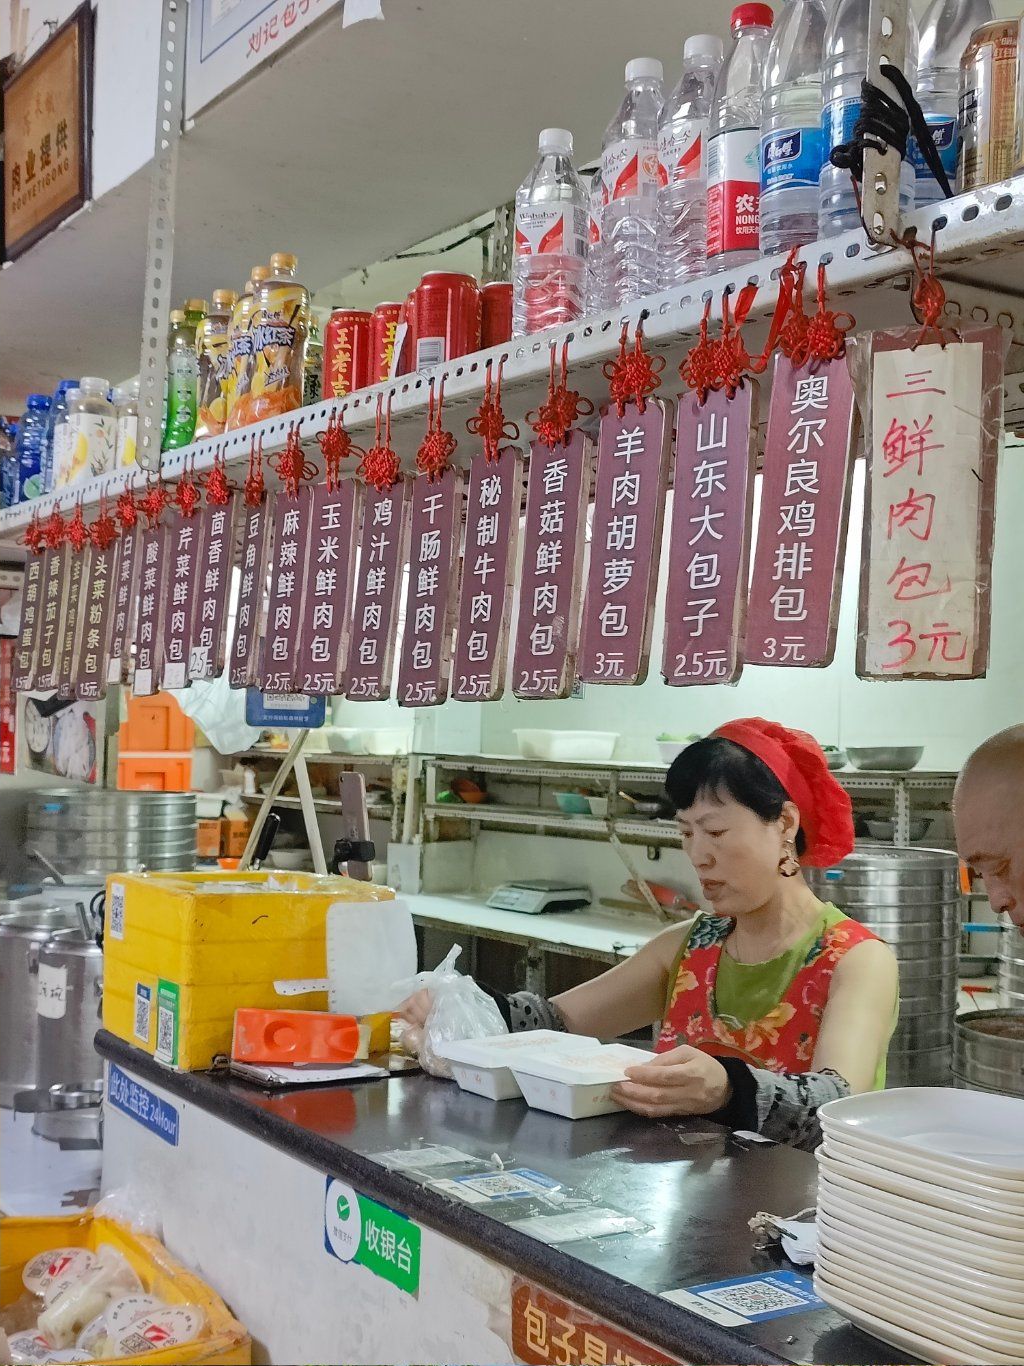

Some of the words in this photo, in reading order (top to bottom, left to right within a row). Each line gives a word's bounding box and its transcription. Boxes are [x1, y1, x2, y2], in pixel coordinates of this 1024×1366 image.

[246, 0, 321, 58] 刘记包子
[736, 194, 759, 213] 农
[598, 426, 645, 637] 羊肉胡萝包
[683, 413, 728, 637] 山东大包子
[769, 374, 829, 622] 奥尔良鸡排包
[883, 369, 951, 601] 三鲜肉包
[169, 526, 194, 661] 芹菜鲜肉包
[199, 510, 226, 650] 茴香鲜肉包
[236, 512, 262, 658] 豆角鲜肉包
[272, 508, 301, 661] 麻辣鲜肉包
[310, 502, 342, 662] 玉米鲜肉包
[359, 497, 393, 665] 鸡汁鲜肉包
[412, 493, 444, 670] 干肠鲜肉包
[467, 474, 502, 662] 秘制牛肉包
[529, 458, 568, 656] 香菇鲜肉包
[139, 540, 160, 669] 酸菜鲜肉包
[762, 636, 806, 662] 3元
[881, 620, 968, 668] 3元
[265, 673, 291, 692] 2.5元
[304, 673, 335, 693] 2.5元
[350, 676, 380, 697] 2.5元
[405, 681, 437, 702] 2.5元
[458, 674, 491, 697] 2.5元
[519, 669, 558, 693] 2.5元
[595, 652, 624, 677] 3元
[673, 650, 727, 678] 2.5元
[110, 1072, 150, 1120] 此处监控
[365, 1219, 413, 1274] 收银台
